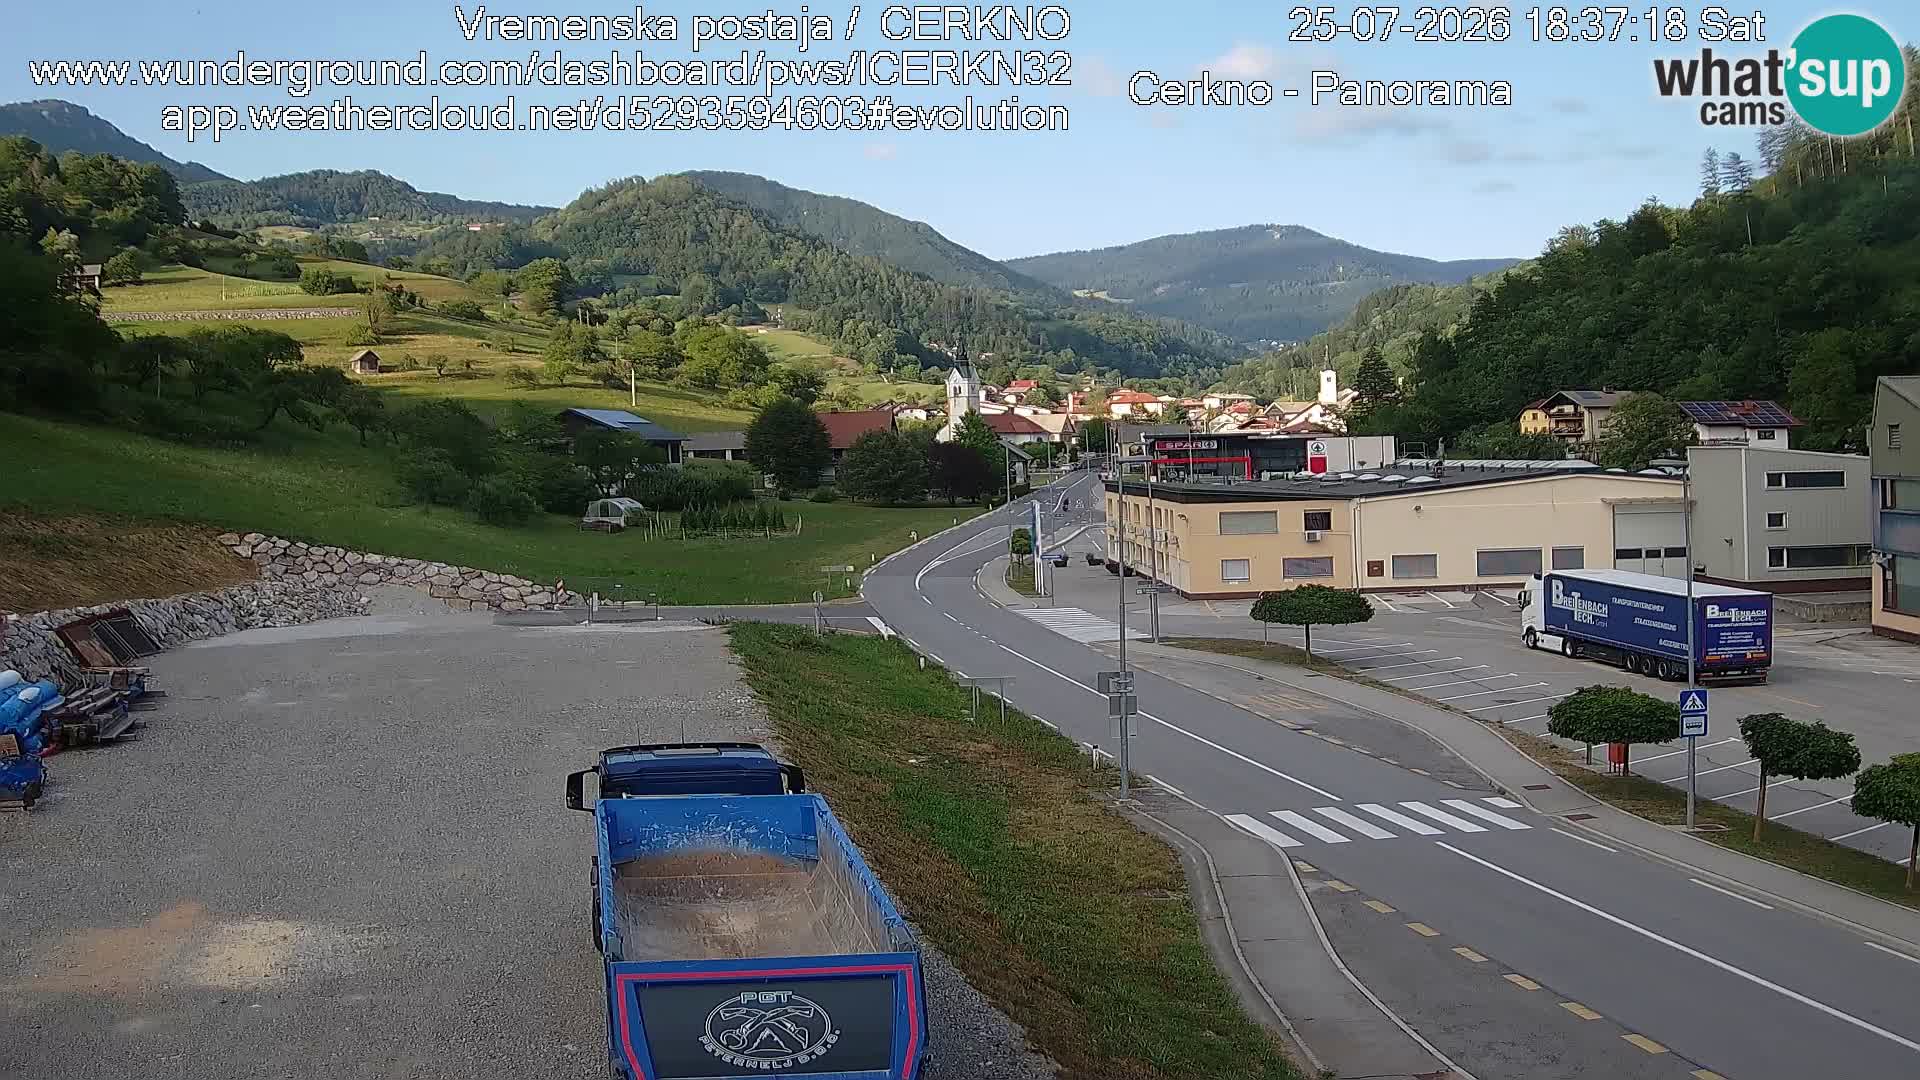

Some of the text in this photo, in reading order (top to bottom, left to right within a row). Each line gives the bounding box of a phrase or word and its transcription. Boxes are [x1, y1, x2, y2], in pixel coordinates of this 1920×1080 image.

[1165, 441, 1202, 449] SPAR
[740, 991, 793, 1004] PGT
[698, 1035, 793, 1069] PETERNELJ
